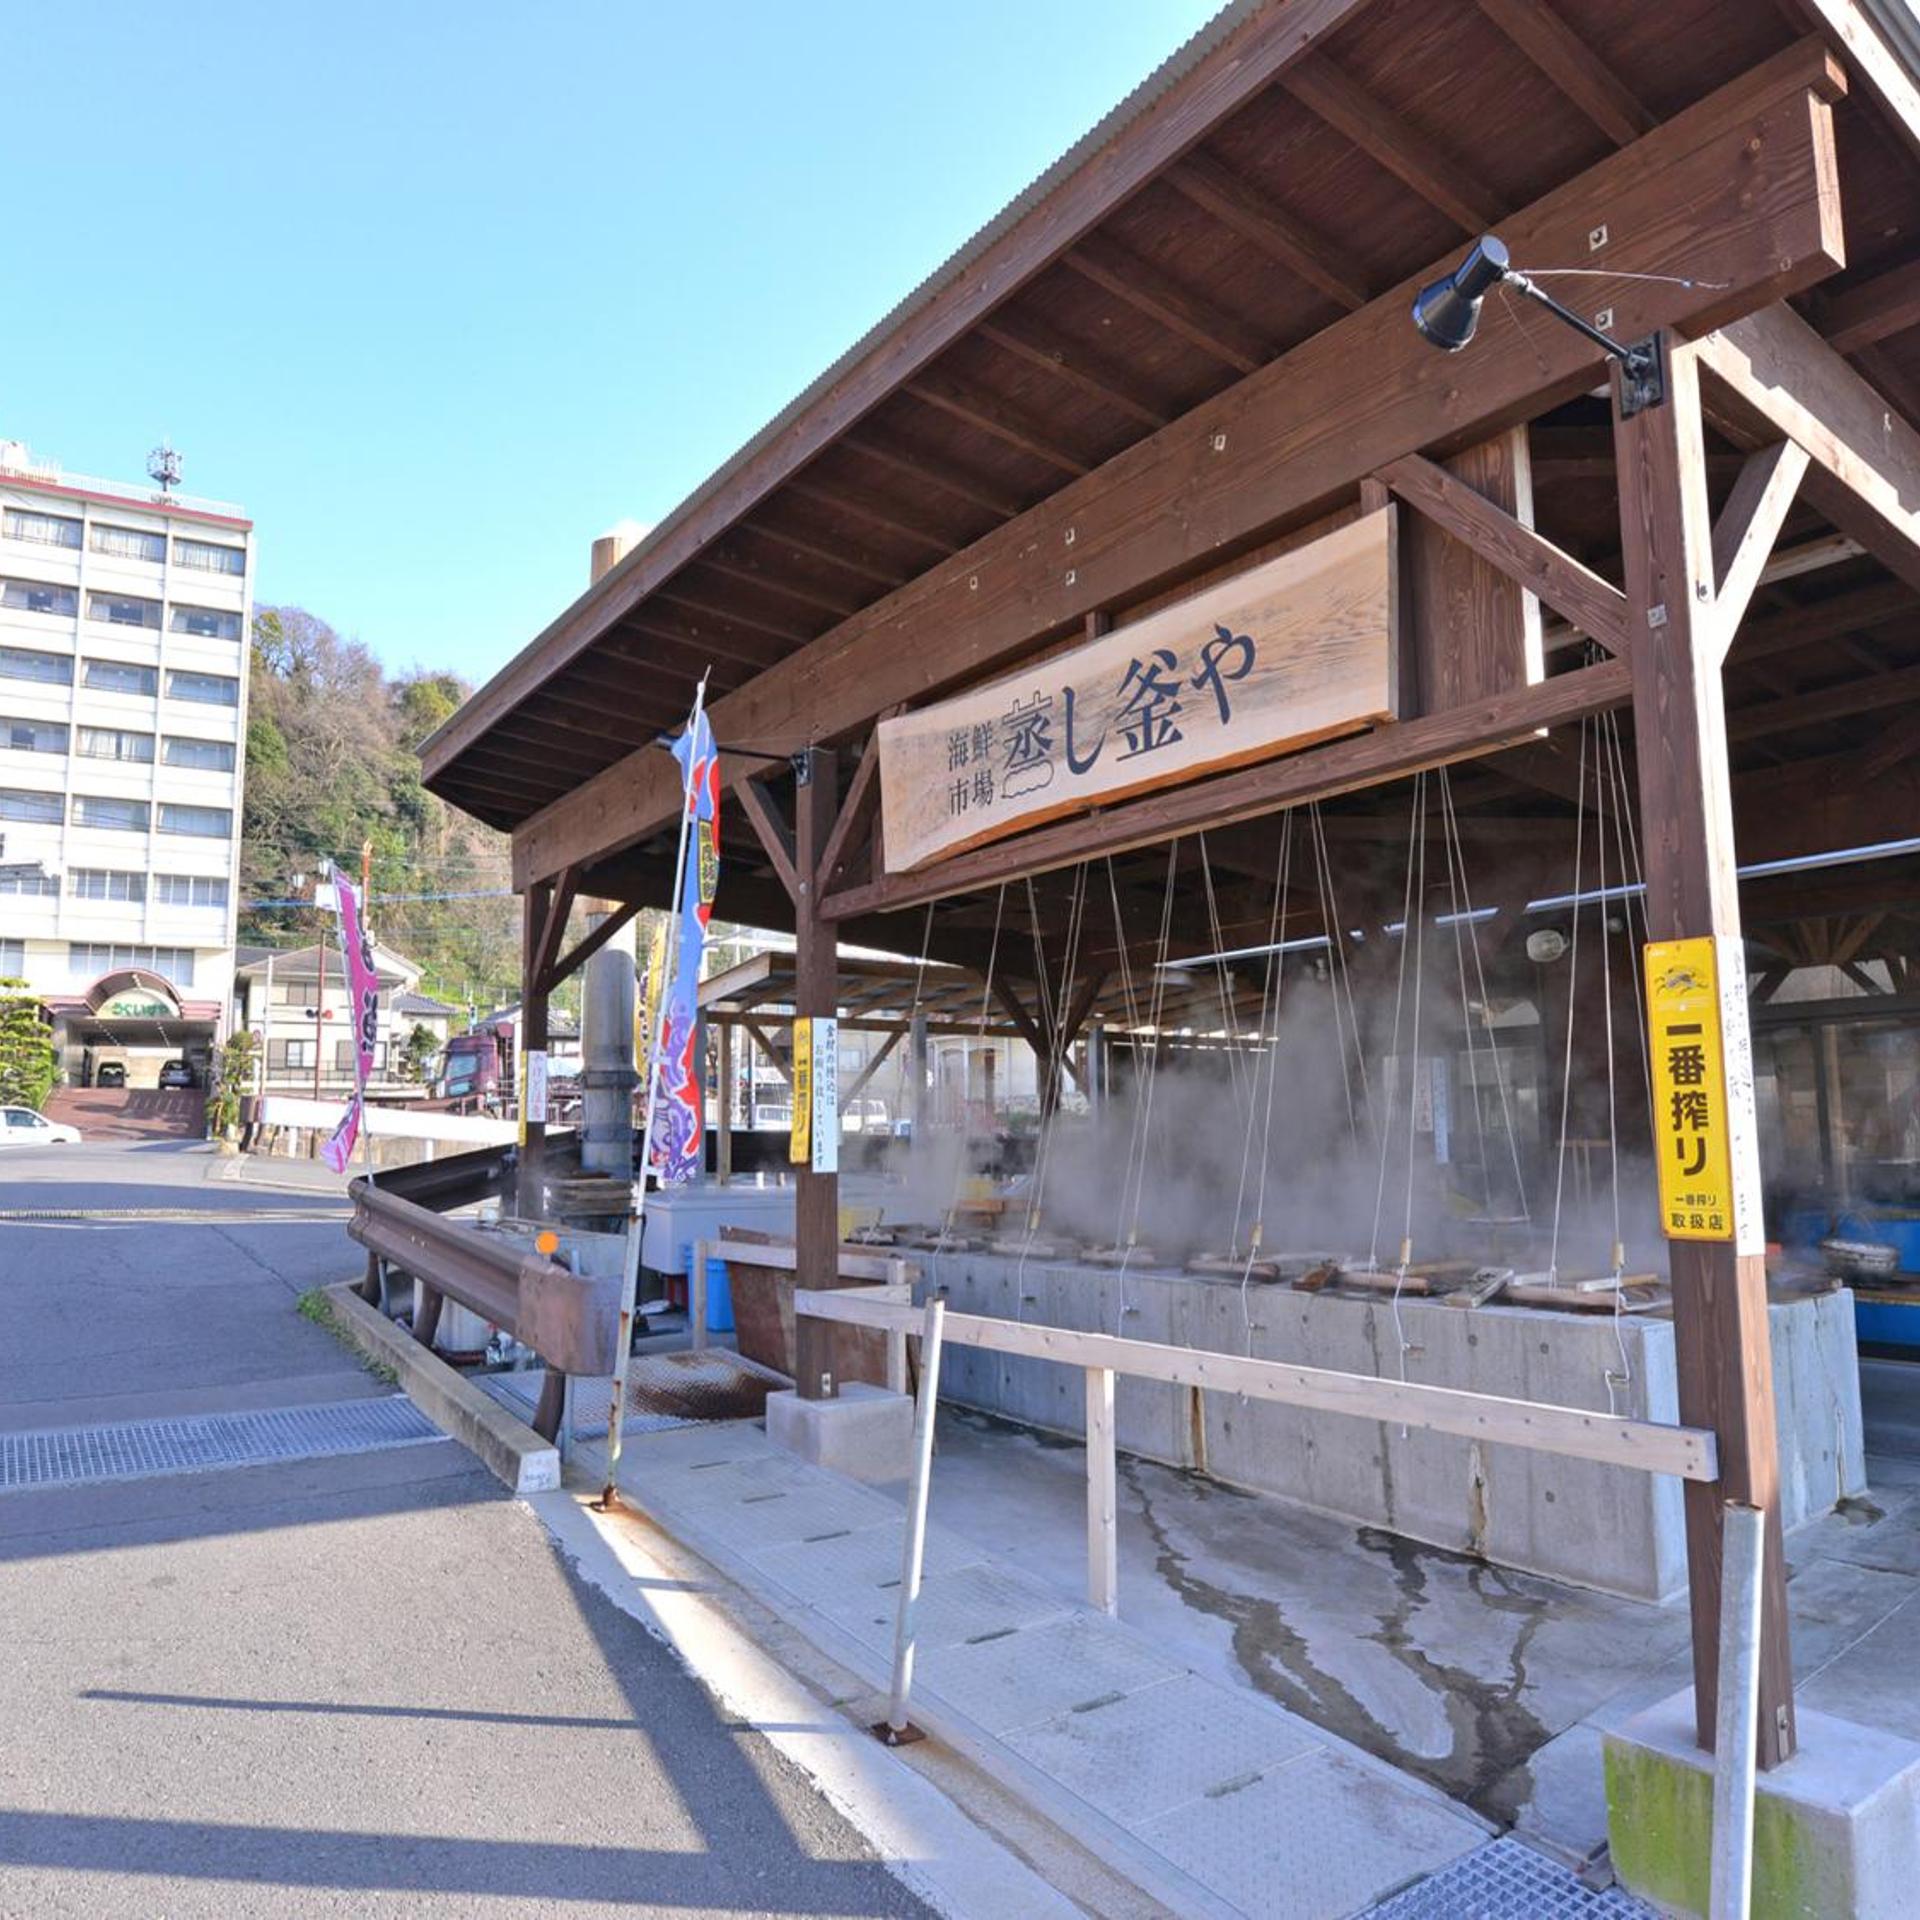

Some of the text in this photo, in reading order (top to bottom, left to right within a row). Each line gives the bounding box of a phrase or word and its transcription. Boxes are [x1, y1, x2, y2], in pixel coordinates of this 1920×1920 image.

[1002, 622, 1257, 799] 蒸し釜や
[948, 720, 993, 772] 海鮮
[949, 769, 994, 816] 市場
[1666, 1023, 1709, 1177] 一番搾り
[1671, 1213, 1723, 1231] 取扱店
[1675, 1194, 1717, 1207] 一番搾り
